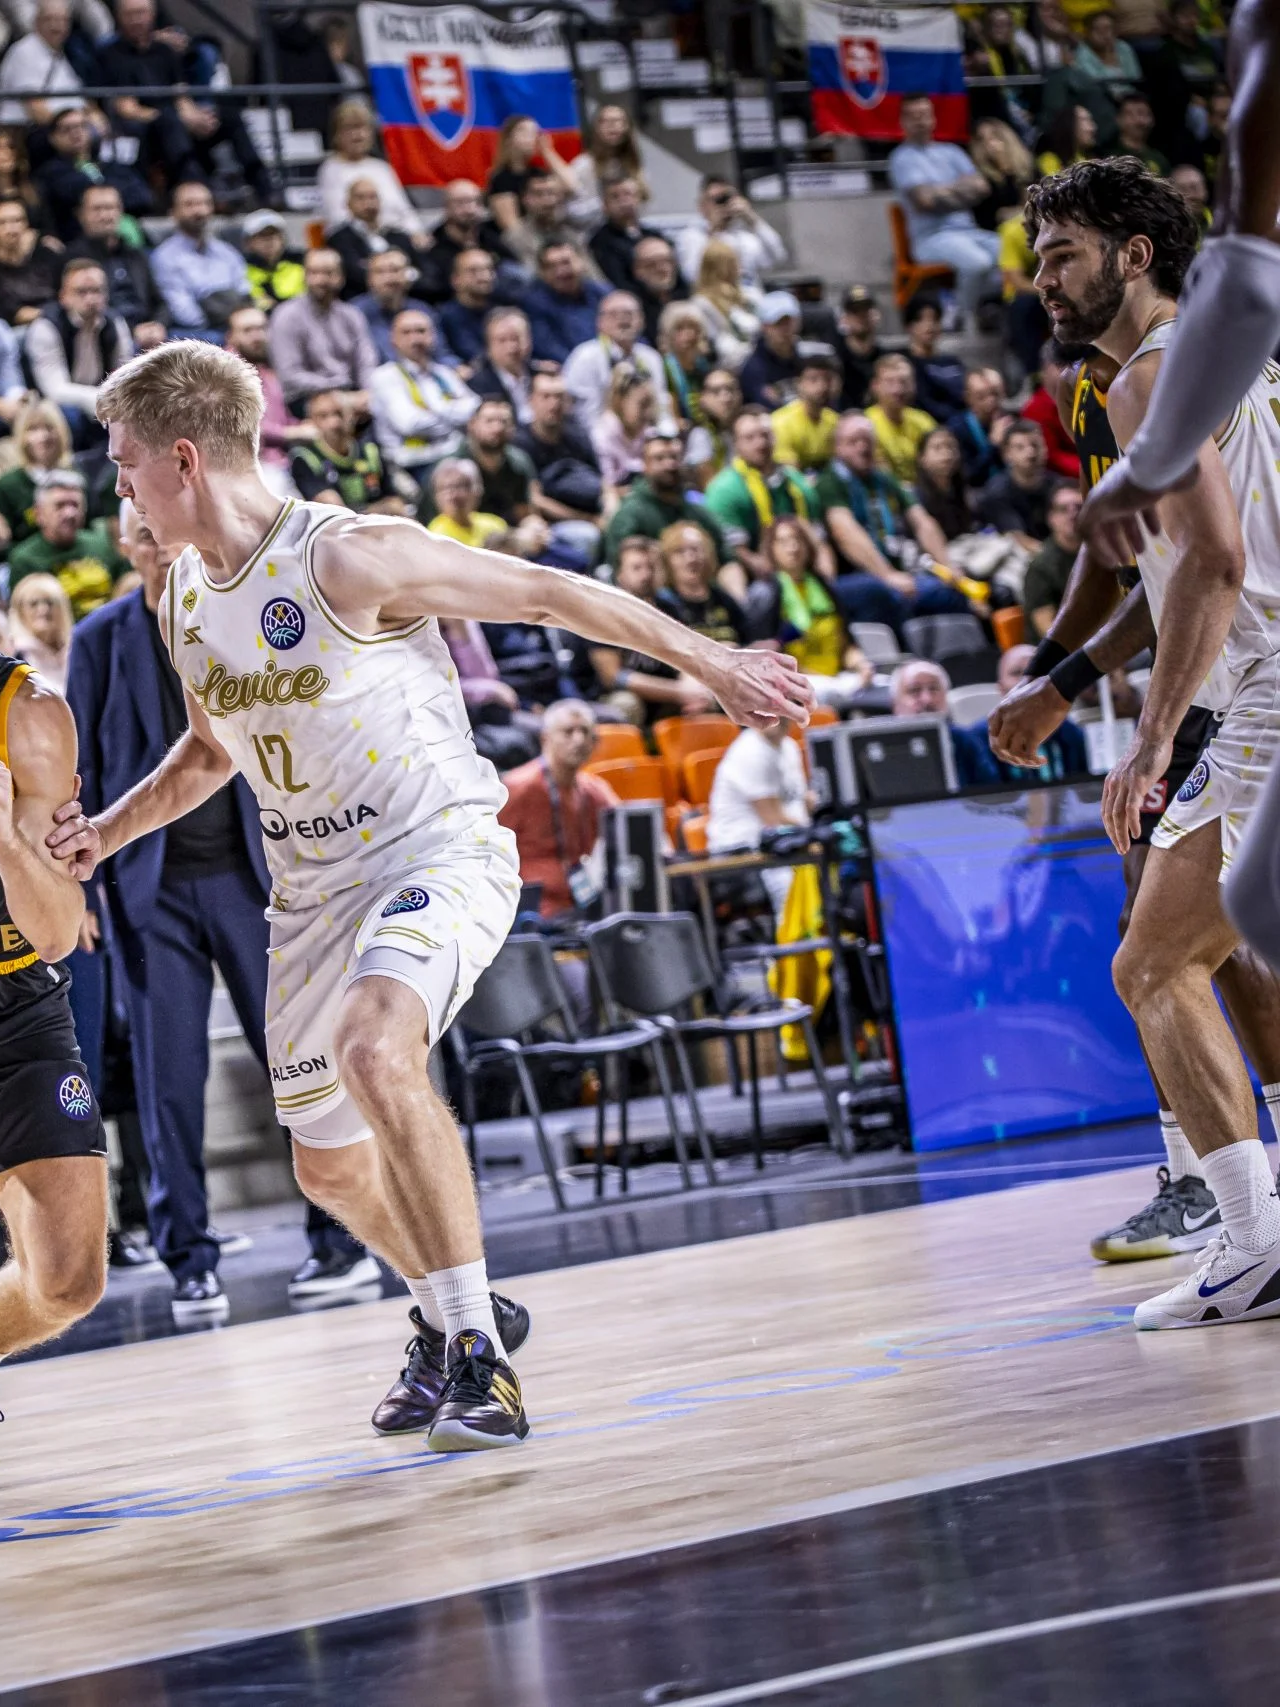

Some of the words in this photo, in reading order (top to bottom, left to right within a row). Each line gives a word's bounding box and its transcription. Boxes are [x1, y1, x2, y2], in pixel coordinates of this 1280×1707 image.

[192, 660, 331, 720] Levice
[252, 734, 311, 794] 12
[271, 1054, 328, 1082] ALEON
